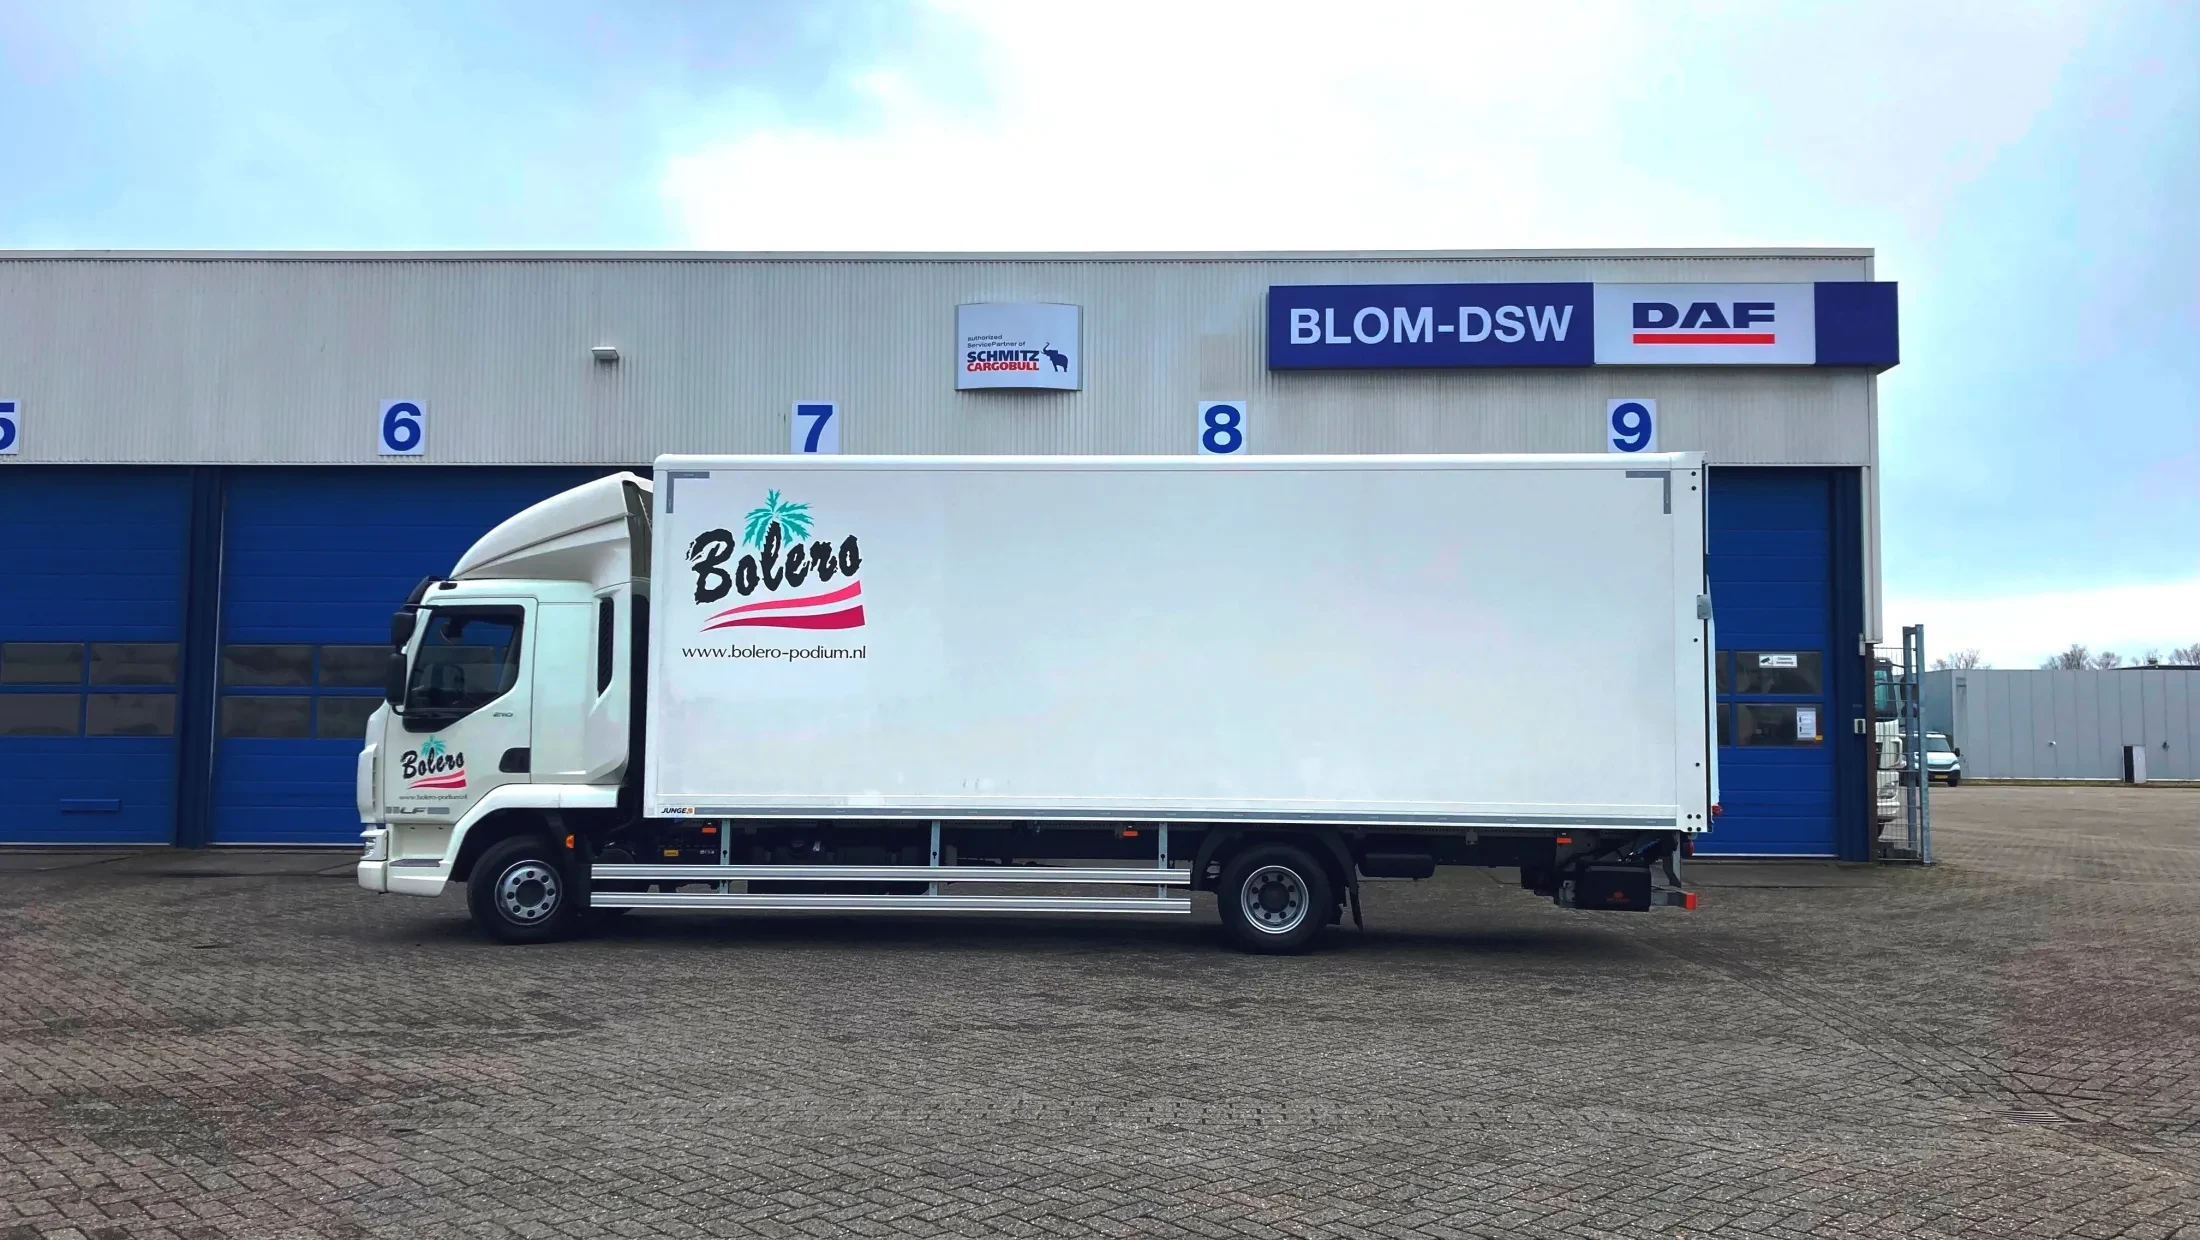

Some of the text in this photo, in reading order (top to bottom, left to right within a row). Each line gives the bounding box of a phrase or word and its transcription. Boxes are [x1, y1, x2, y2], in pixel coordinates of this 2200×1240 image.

[1290, 305, 1573, 344] BLOM-DSW
[1632, 302, 1776, 329] DAF
[967, 350, 1039, 362] SCHMITZ
[967, 361, 1039, 371] CARGOBULL
[383, 402, 422, 452] 6
[797, 404, 834, 453] 7
[1202, 404, 1243, 454] 8
[1611, 402, 1652, 453] 9
[685, 520, 863, 605] Bolero
[681, 644, 867, 662] www.bolero-podium.nl
[401, 747, 465, 779] Bolero
